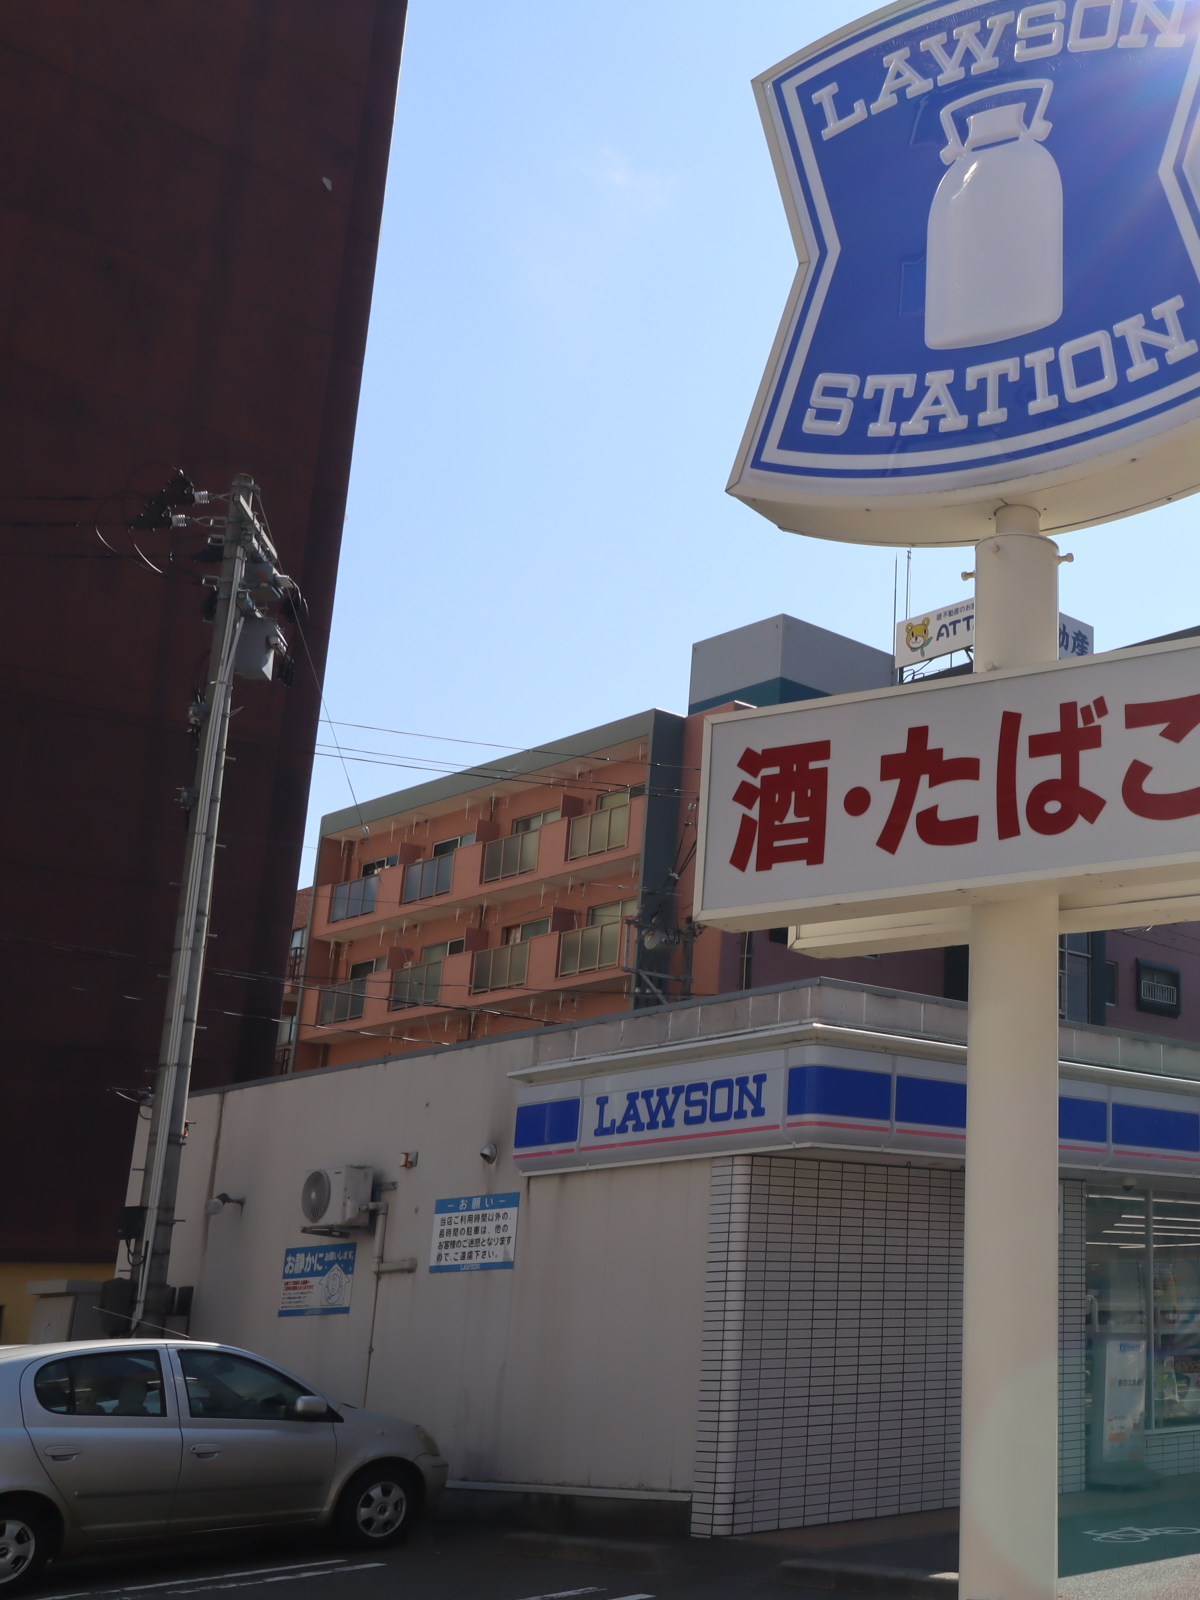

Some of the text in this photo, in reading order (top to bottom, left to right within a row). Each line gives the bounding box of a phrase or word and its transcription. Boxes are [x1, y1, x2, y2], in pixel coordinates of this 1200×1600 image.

[811, 0, 1193, 142] LAWSON
[801, 294, 1200, 438] STATION
[936, 614, 974, 642] ATT
[593, 1072, 767, 1137] LAWSON
[284, 1252, 324, 1275] お静かに
[437, 1236, 512, 1250] お客様のご迷惑となります
